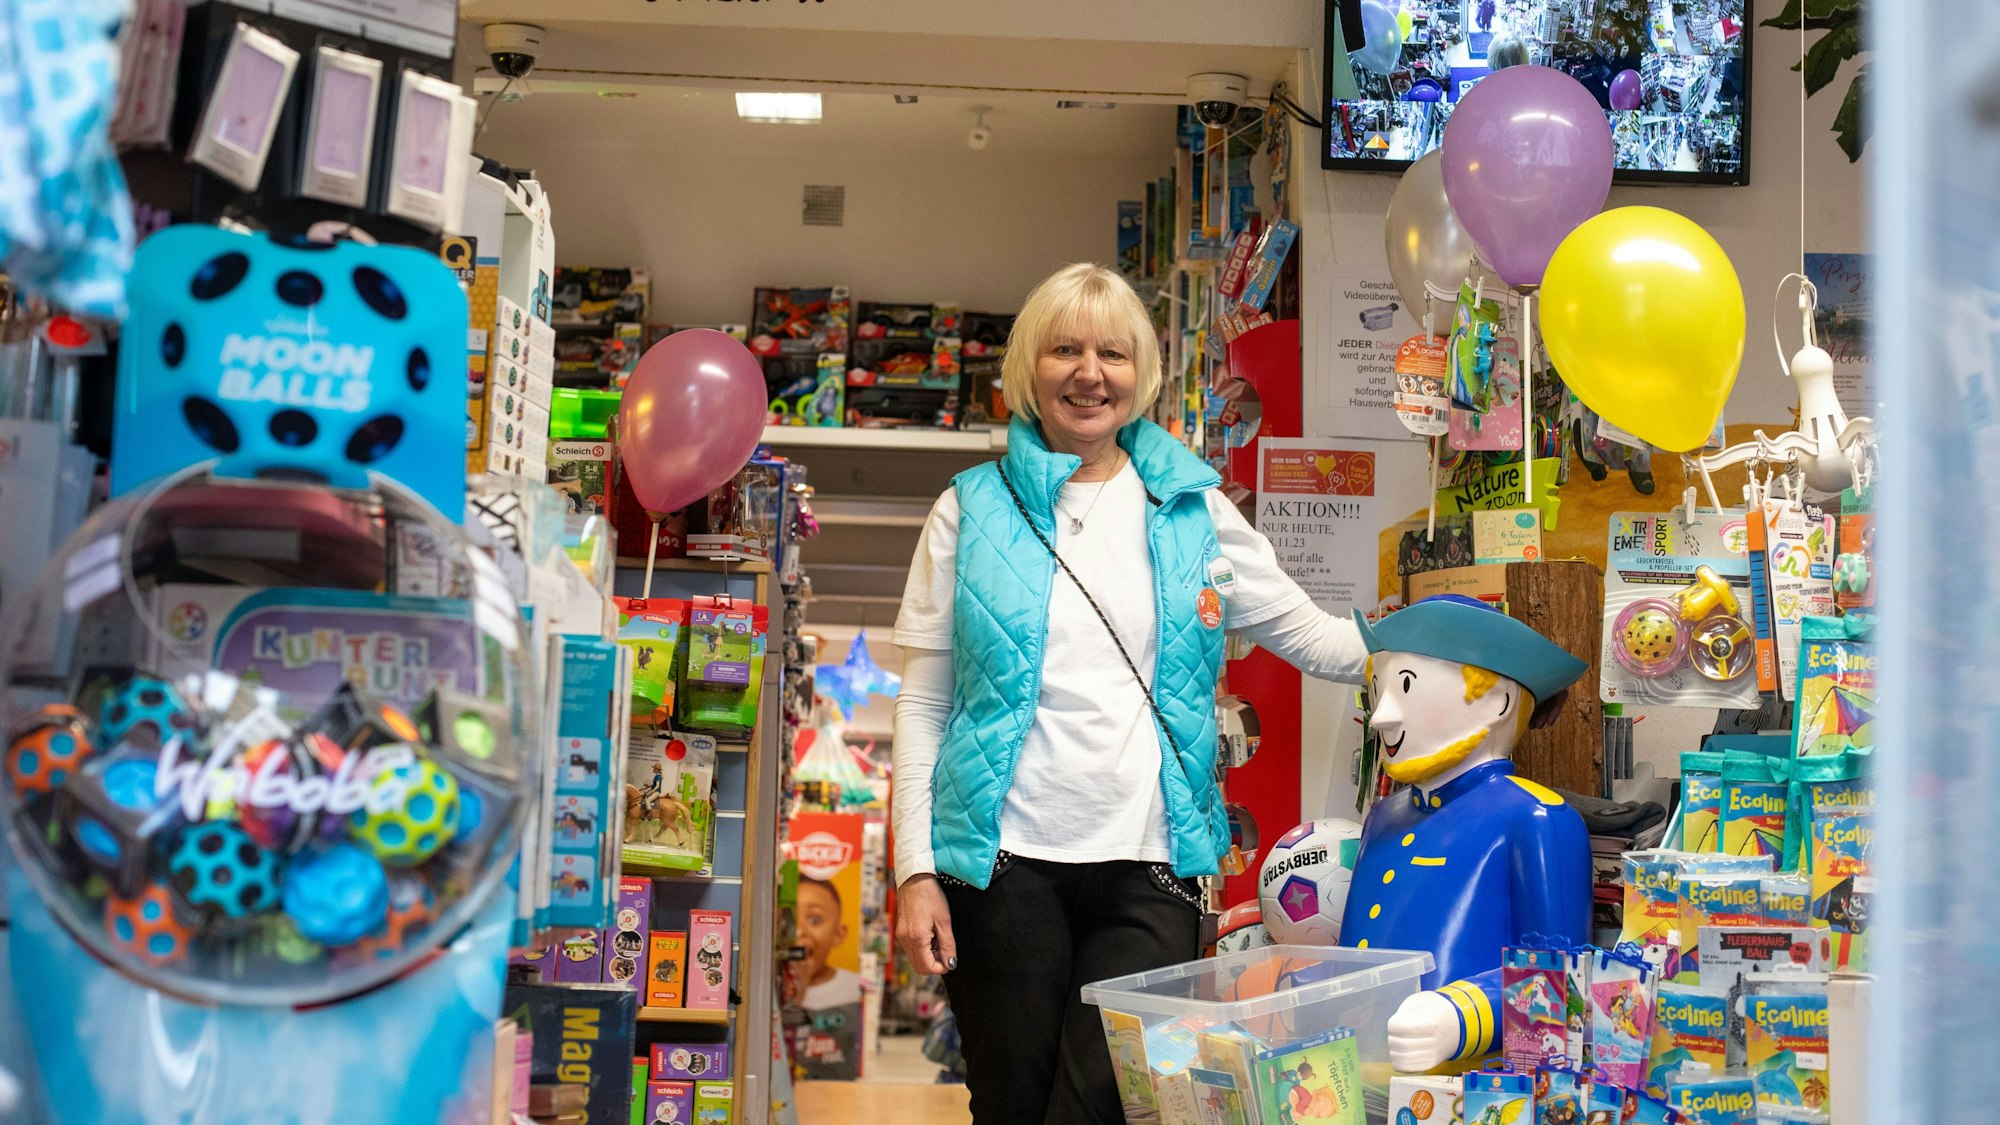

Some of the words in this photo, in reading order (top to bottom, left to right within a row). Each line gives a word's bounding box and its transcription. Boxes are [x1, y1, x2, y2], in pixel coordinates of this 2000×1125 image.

[1359, 280, 1396, 290] Geschä
[219, 333, 374, 377] MOON
[1338, 339, 1372, 349] JEDER
[1340, 352, 1358, 360] wird
[1361, 353, 1376, 361] zur
[217, 367, 372, 413] BALLS
[1368, 376, 1386, 385] und
[556, 447, 591, 455] Schleich
[1454, 468, 1520, 513] Nature
[1262, 501, 1361, 520] AKTION!!!
[1262, 522, 1288, 533] NUR
[1291, 523, 1335, 536] HEUTE,
[1654, 517, 1668, 556] SPORT
[1287, 552, 1305, 562] auf
[1306, 553, 1324, 563] alle
[261, 628, 424, 668] KUNTER
[1763, 649, 1771, 679] nano
[1263, 850, 1328, 887] DERBYSTAR
[1689, 881, 1758, 907] Ecoline
[1726, 935, 1788, 946] FLEDERMAUS-
[1746, 948, 1769, 959] BALL
[1656, 997, 1724, 1027] Ecoline
[1756, 1001, 1828, 1028] Ecoline
[557, 1007, 600, 1125] Mag
[656, 1087, 683, 1095] schleich
[1328, 1060, 1349, 1109] Töpfchen
[1681, 1089, 1753, 1115] Ecoline
